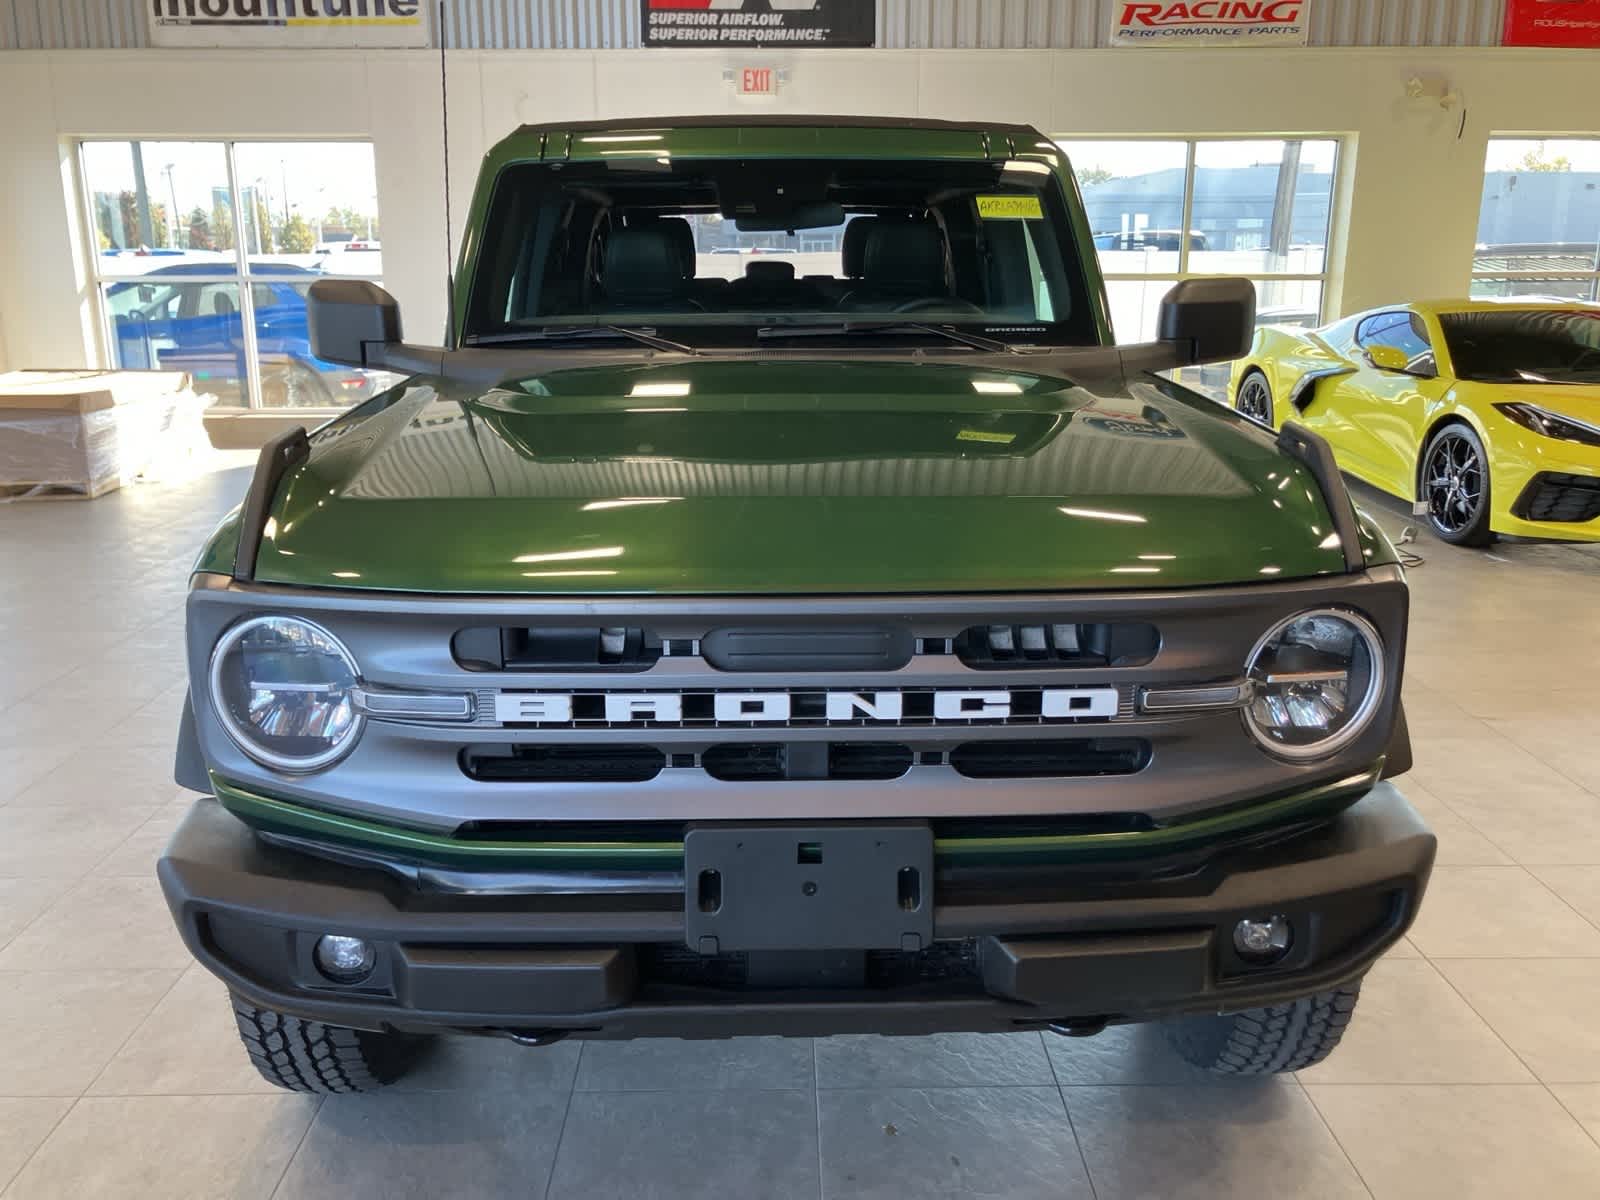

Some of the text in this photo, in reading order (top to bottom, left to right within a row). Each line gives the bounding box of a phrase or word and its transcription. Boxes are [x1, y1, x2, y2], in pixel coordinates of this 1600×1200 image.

[649, 12, 784, 26] SUPERIOR AIRFLOW.
[1119, 0, 1304, 26] RACING
[649, 28, 718, 40] SUPERIOR
[1118, 26, 1301, 37] PERFORMANCE PARTS
[743, 68, 771, 92] EXIT
[495, 688, 1119, 723] BRONCO
